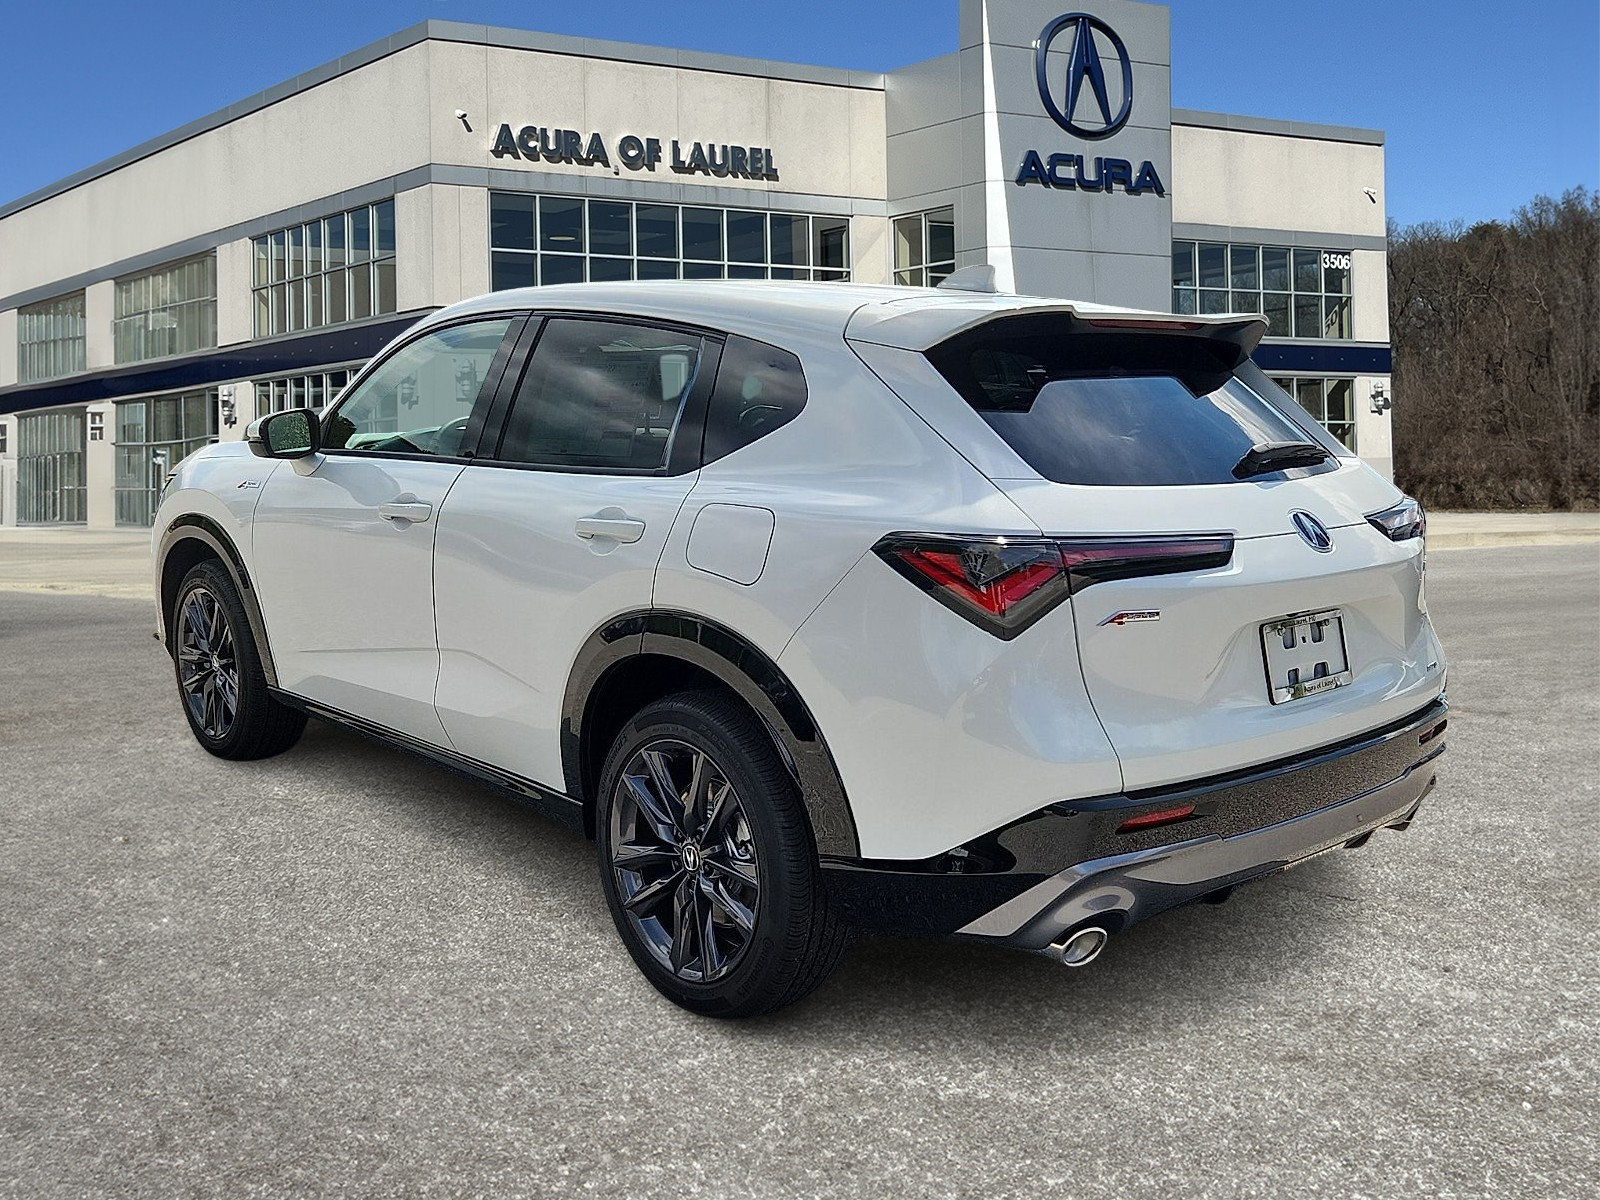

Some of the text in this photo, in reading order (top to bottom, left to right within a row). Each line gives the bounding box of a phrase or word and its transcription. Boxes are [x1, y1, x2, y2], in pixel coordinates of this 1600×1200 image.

[490, 123, 779, 181] ACURA OF LAUREL
[1015, 150, 1166, 198] ACURA
[1322, 253, 1351, 270] 3506
